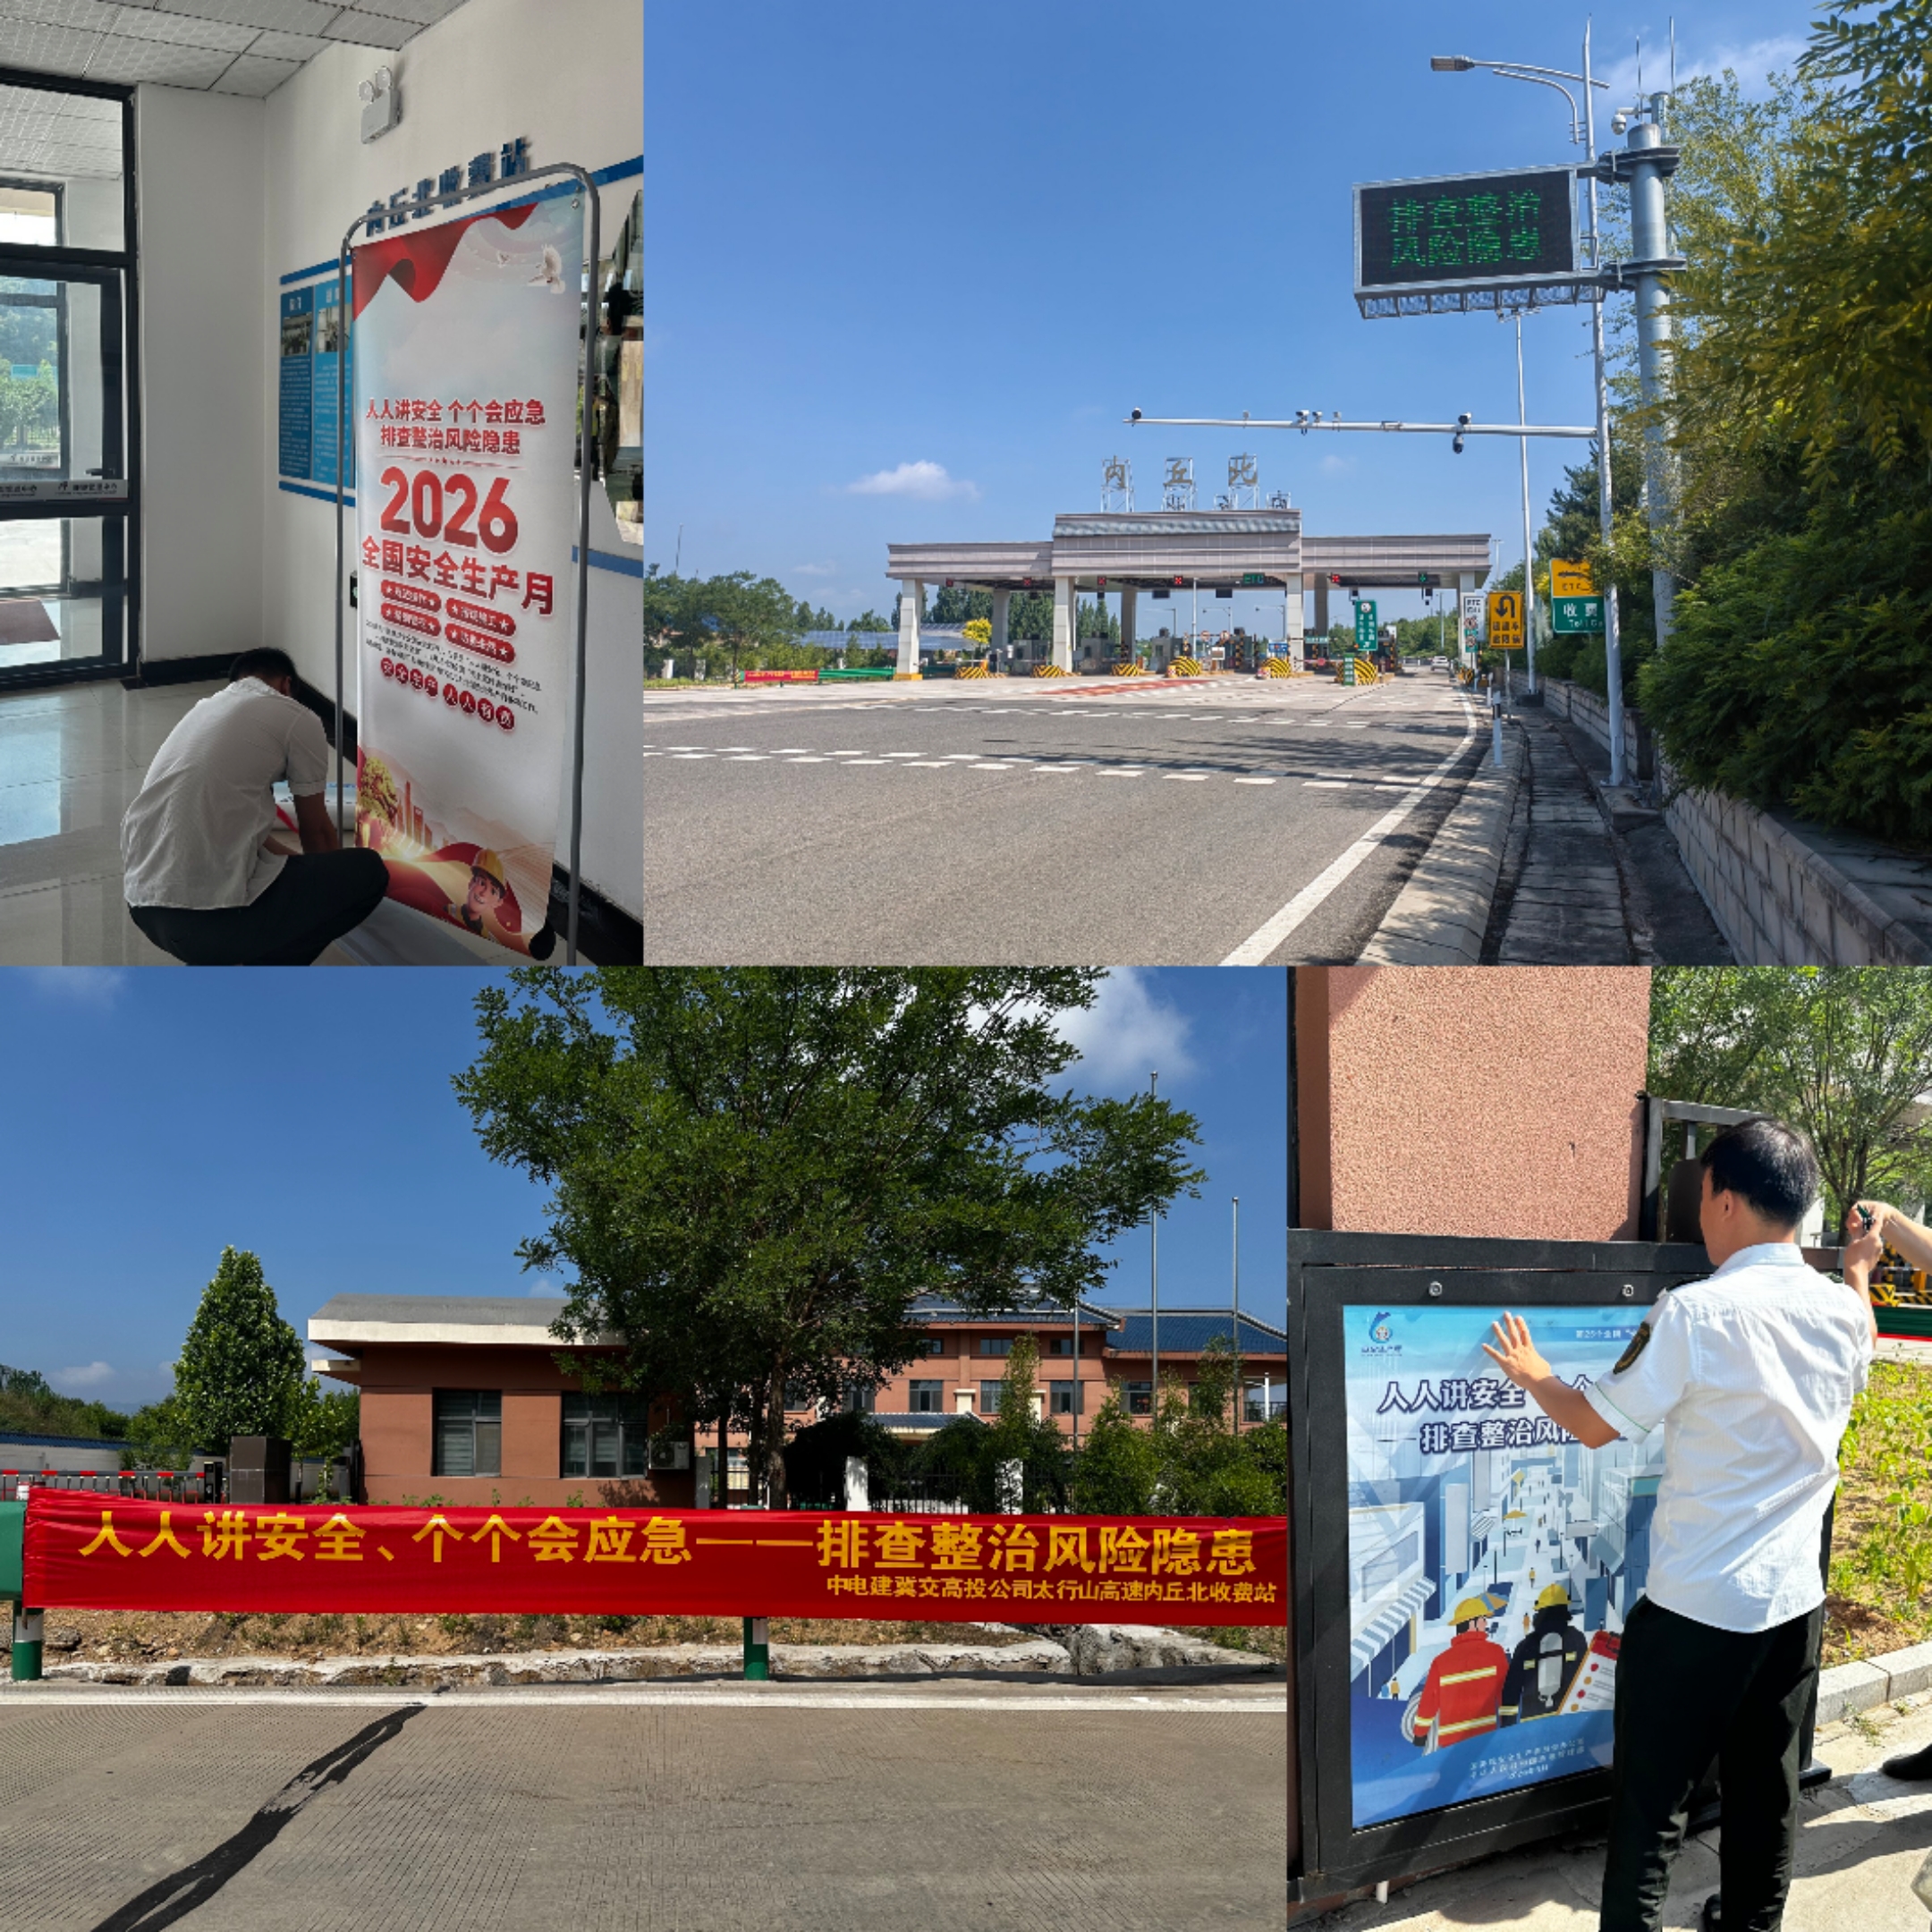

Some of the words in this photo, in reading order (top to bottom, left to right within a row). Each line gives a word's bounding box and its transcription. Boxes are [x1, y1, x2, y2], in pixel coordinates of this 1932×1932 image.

[1389, 226, 1542, 268] 风险隐患
[366, 398, 443, 422] 人人讲安全
[447, 399, 547, 426] 个个会应急
[380, 425, 521, 454] 排查整治风险隐患
[1104, 453, 1258, 489] 内丘北
[380, 466, 519, 554] 2026
[361, 535, 555, 615] 全国安全生产月
[1377, 1378, 1526, 1413] 人人讲安全
[826, 1574, 1276, 1605] 中电建冀交高投公司太行山高速内丘北收费站
